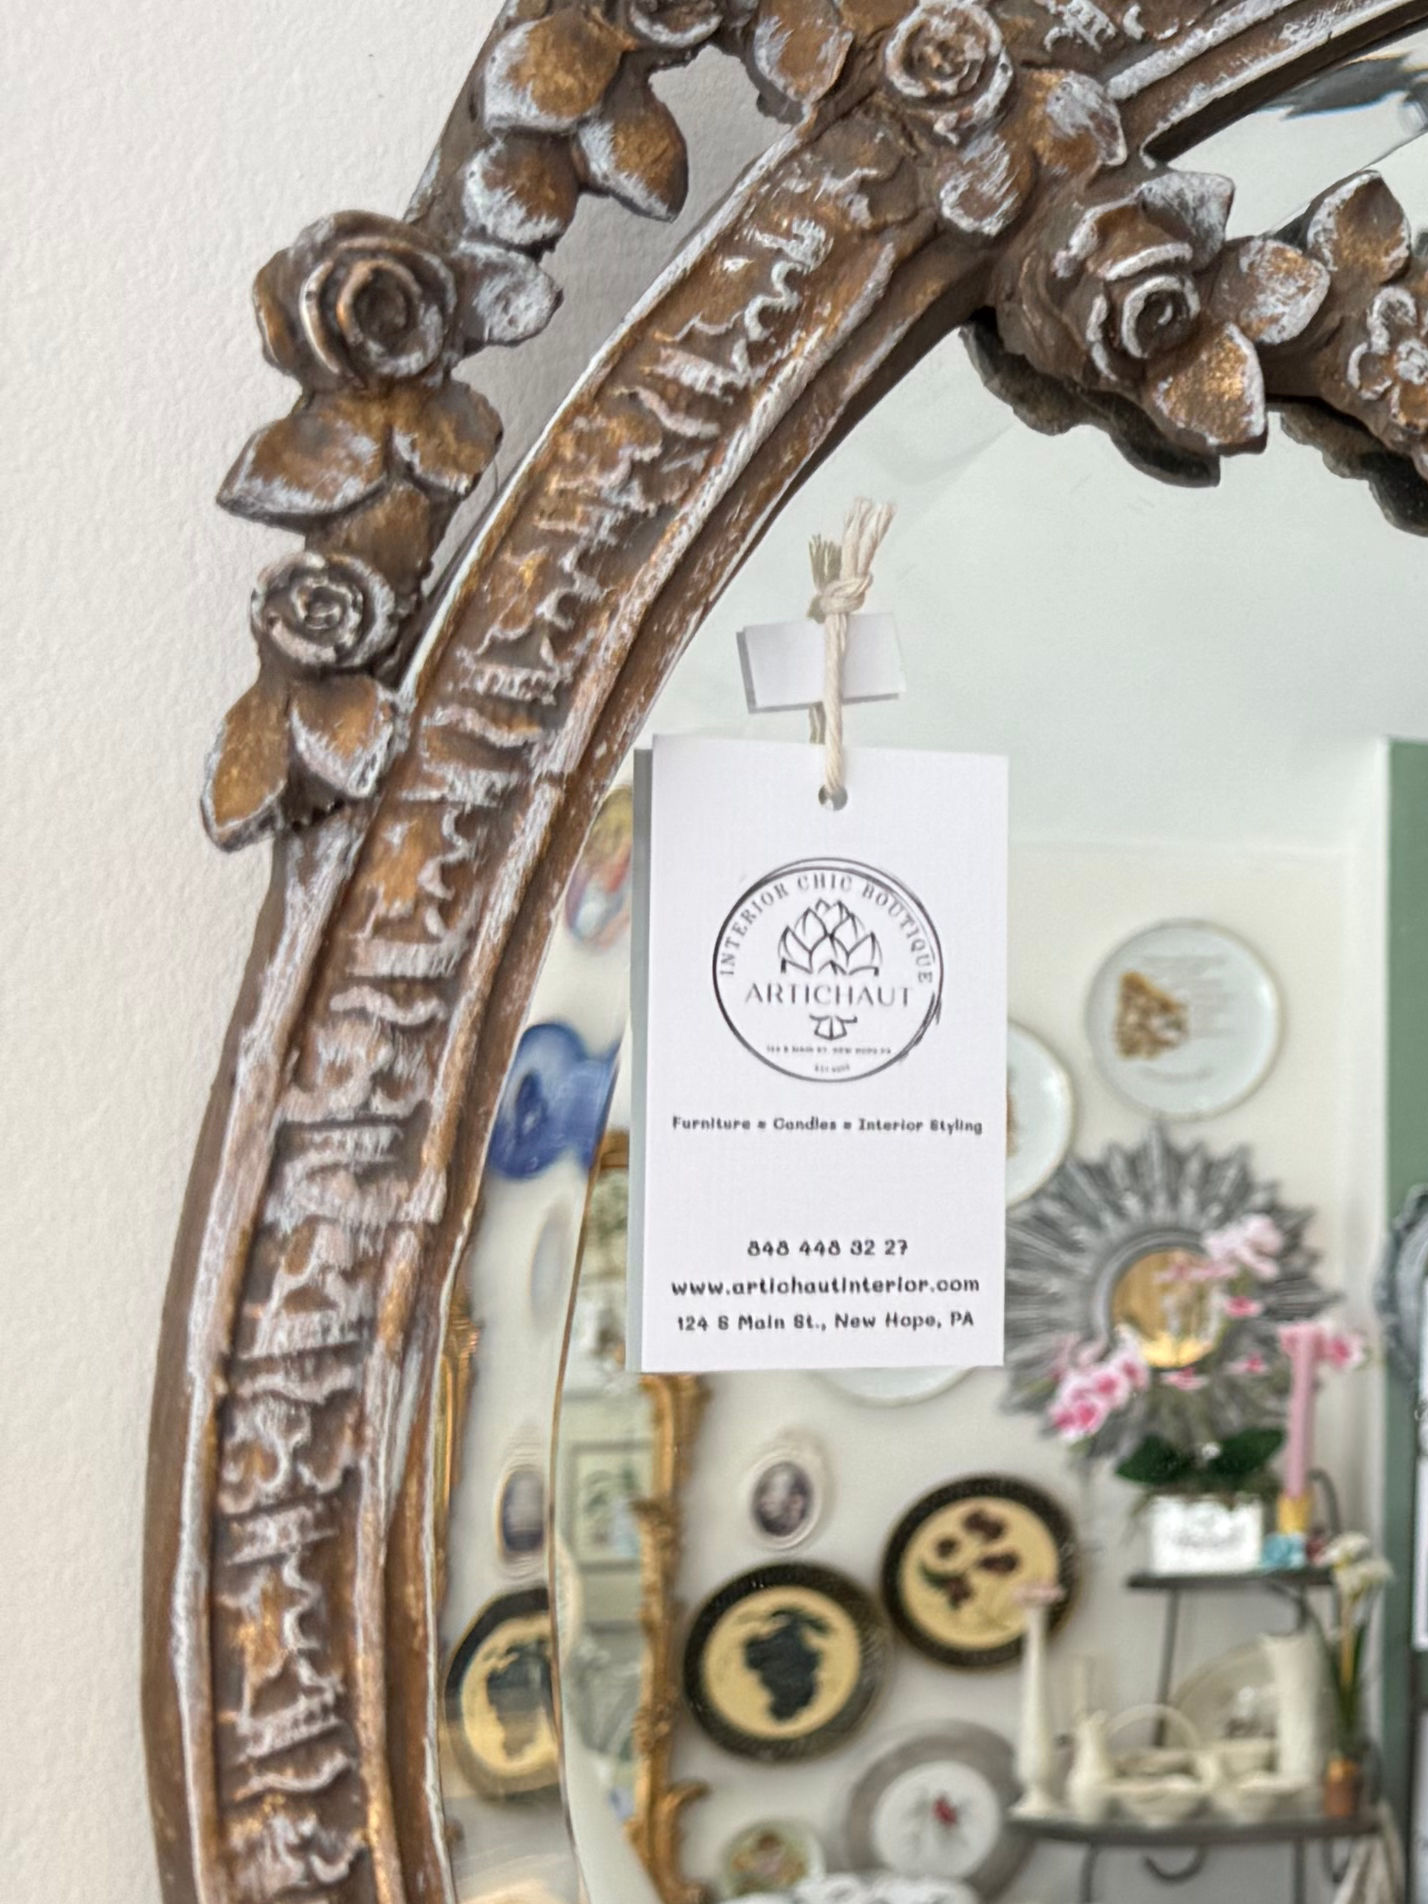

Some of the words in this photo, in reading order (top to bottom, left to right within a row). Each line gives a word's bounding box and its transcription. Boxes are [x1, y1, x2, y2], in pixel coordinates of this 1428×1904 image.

[720, 883, 789, 976] INTERIOR
[797, 873, 852, 892] CHIC
[861, 884, 933, 984] BOUTIQUE
[745, 982, 911, 1008] ARTICHAUT
[671, 1115, 752, 1130] Furniture
[772, 1115, 837, 1131] Candles
[858, 1117, 924, 1132] Interior
[929, 1117, 983, 1137] Styling
[884, 1238, 909, 1257] 27
[670, 1274, 980, 1297] www.artichautinterior.com
[676, 1314, 710, 1333] 124
[717, 1314, 730, 1332] S
[737, 1313, 786, 1332] Main
[833, 1311, 877, 1330] New
[884, 1311, 943, 1333] Hope,
[949, 1309, 975, 1328] PA
